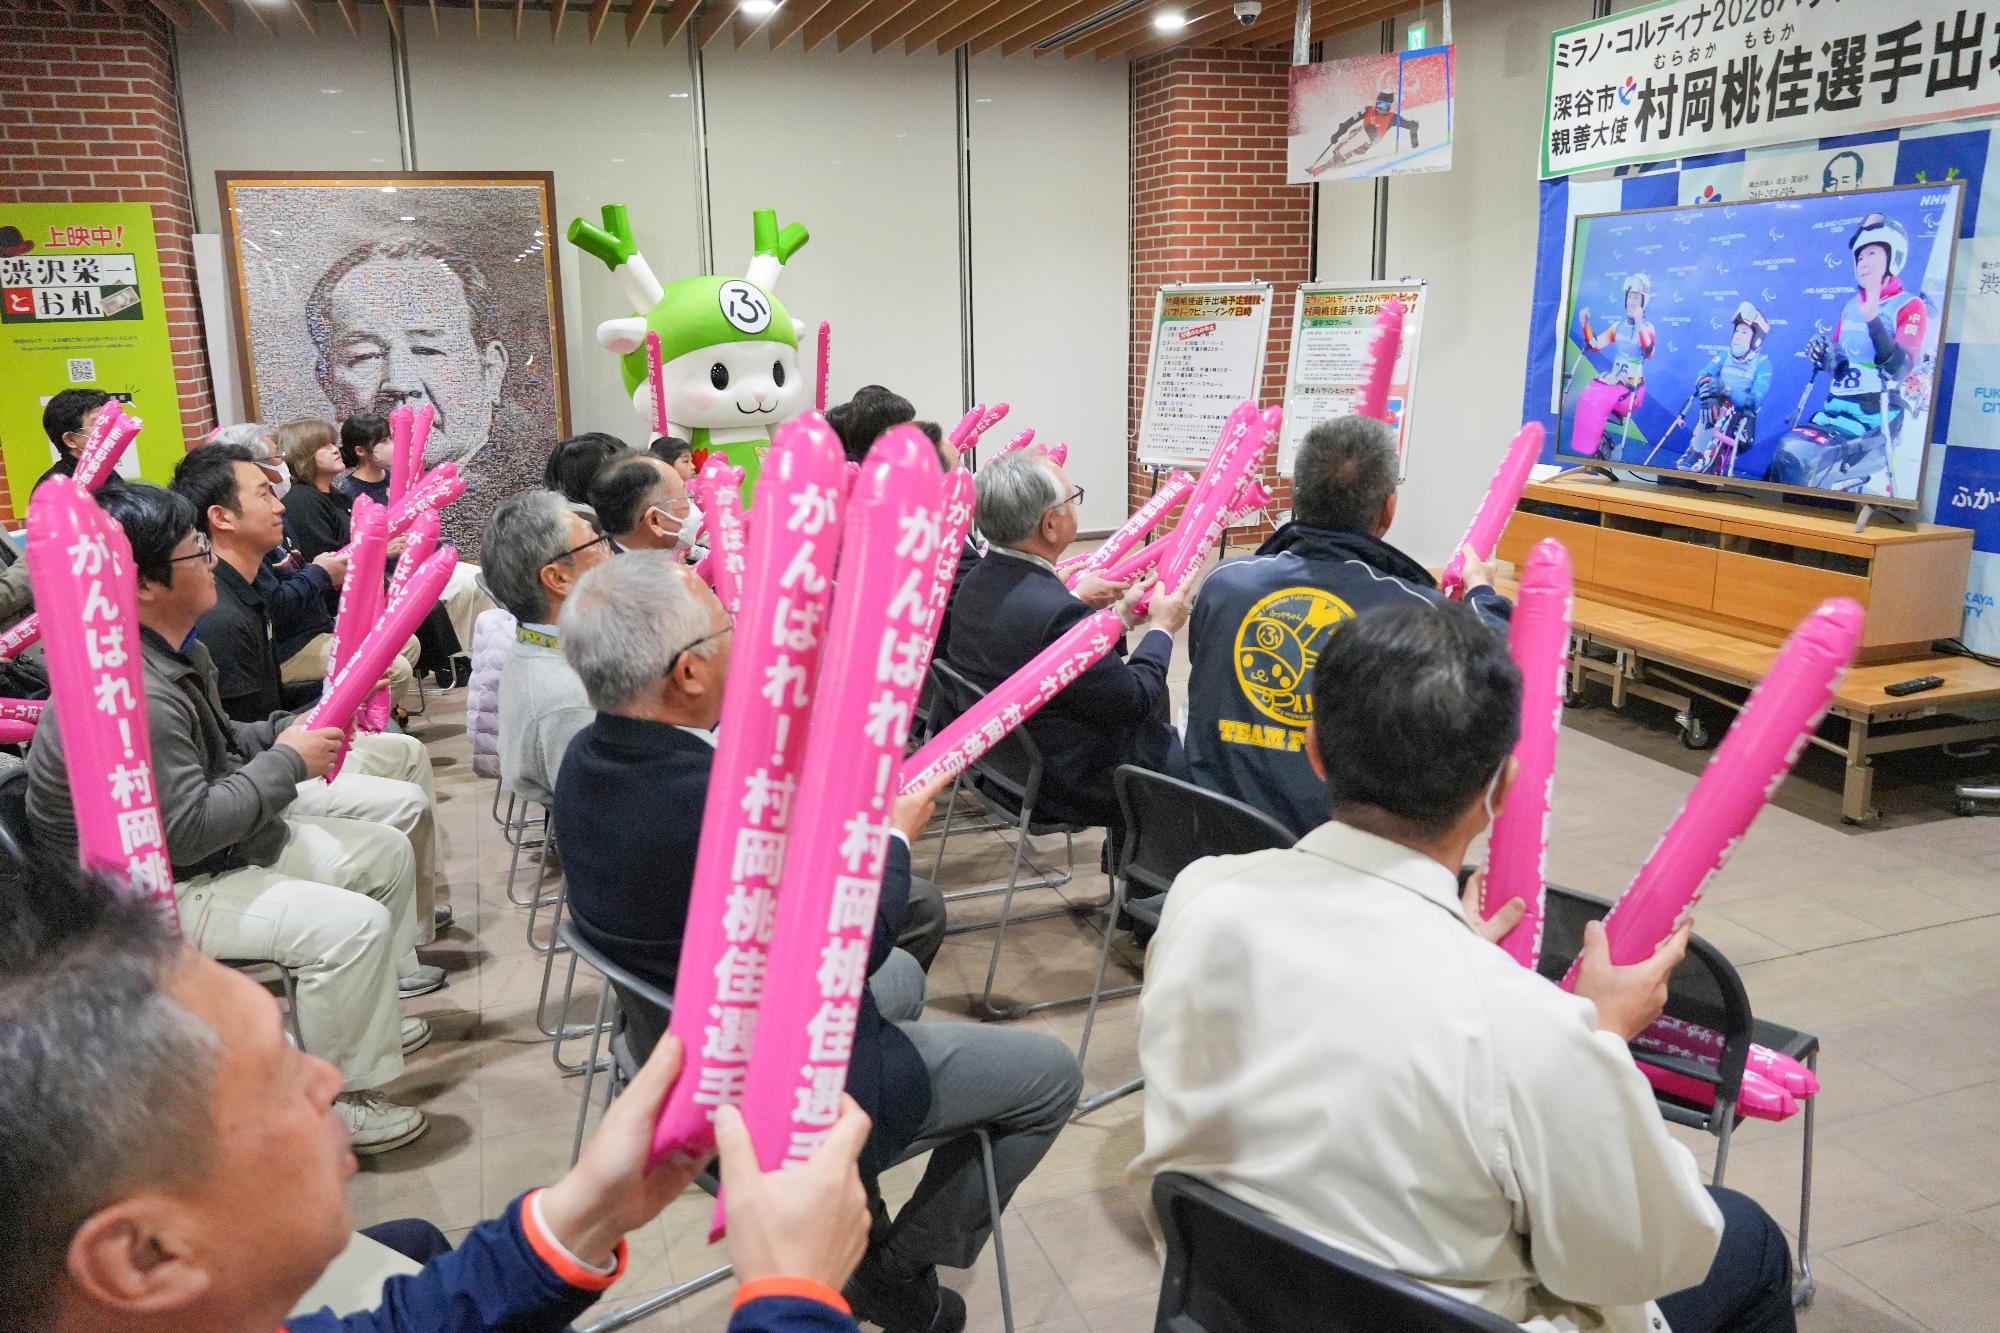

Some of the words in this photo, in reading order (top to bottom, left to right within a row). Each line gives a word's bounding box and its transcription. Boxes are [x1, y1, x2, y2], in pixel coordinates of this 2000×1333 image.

[1653, 42, 1717, 70] むらおか
[1744, 23, 1795, 49] ももか
[1552, 84, 1617, 121] 深谷市
[1551, 115, 1629, 157] 親善大使
[4, 257, 133, 285] 渋沢栄一
[10, 290, 101, 316] とお札
[729, 288, 767, 324] ふ
[1218, 719, 1286, 750] TEAM
